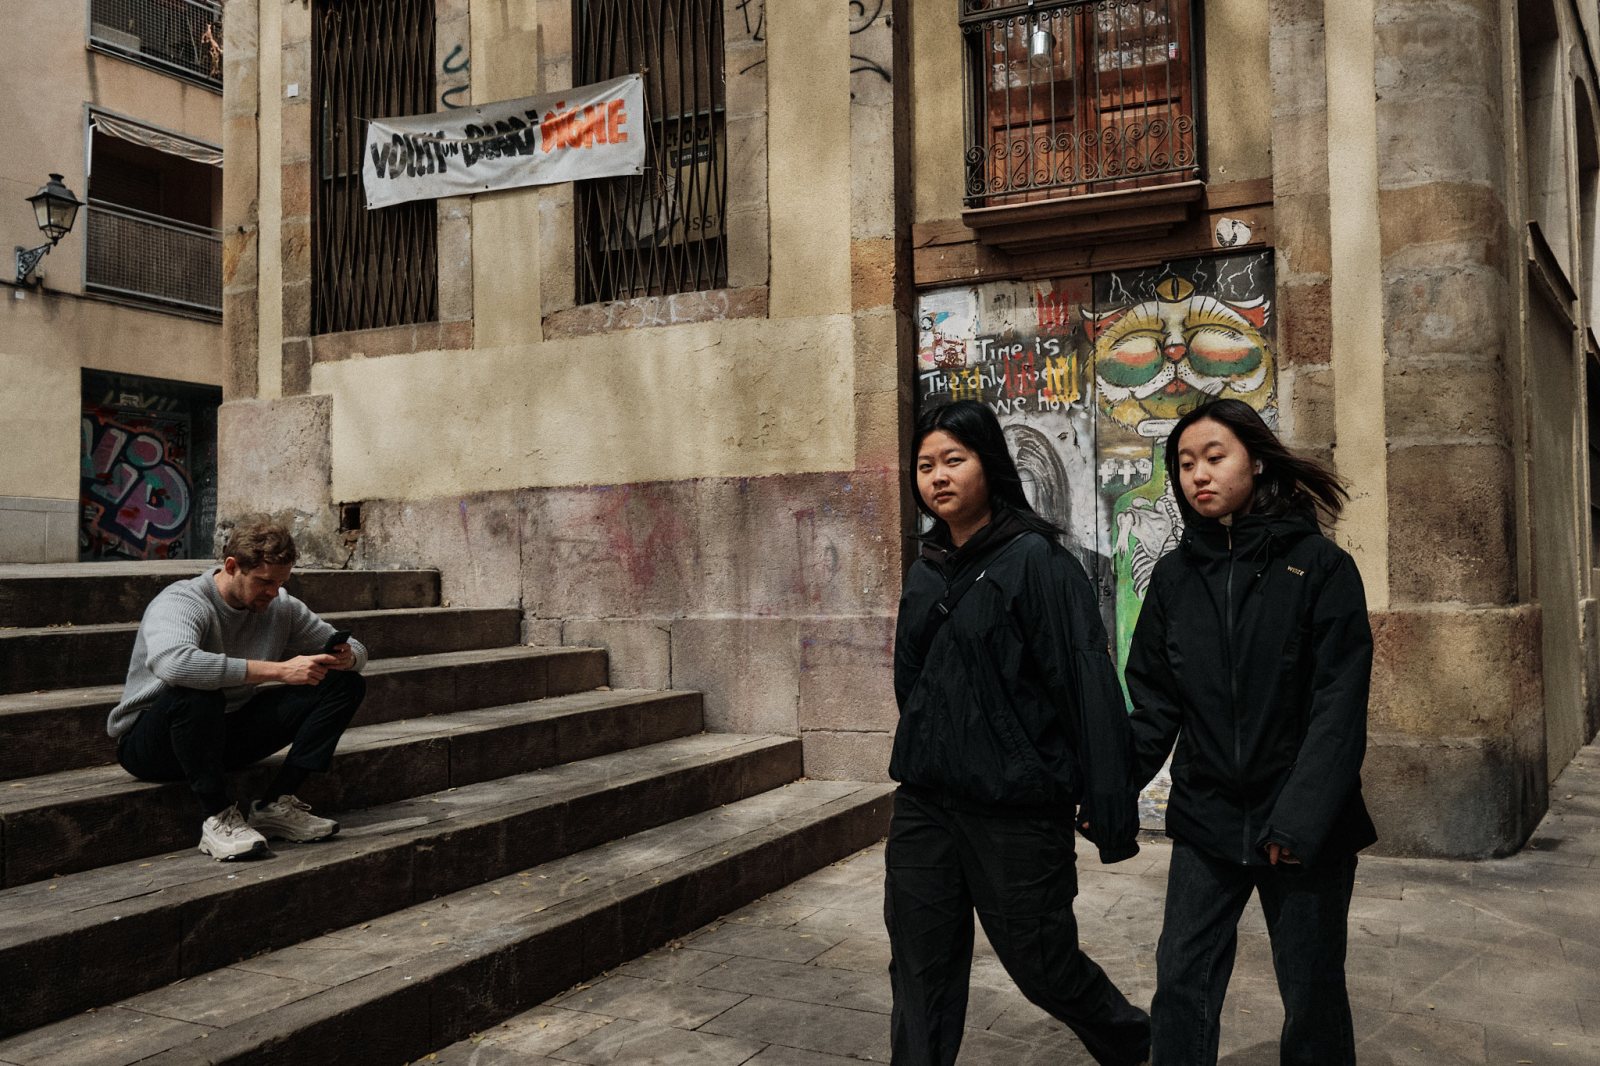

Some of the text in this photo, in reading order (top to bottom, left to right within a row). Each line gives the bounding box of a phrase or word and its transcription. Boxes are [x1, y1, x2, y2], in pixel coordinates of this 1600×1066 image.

[441, 142, 459, 157] UN
[1035, 336, 1060, 356] is
[967, 364, 1007, 397] only
